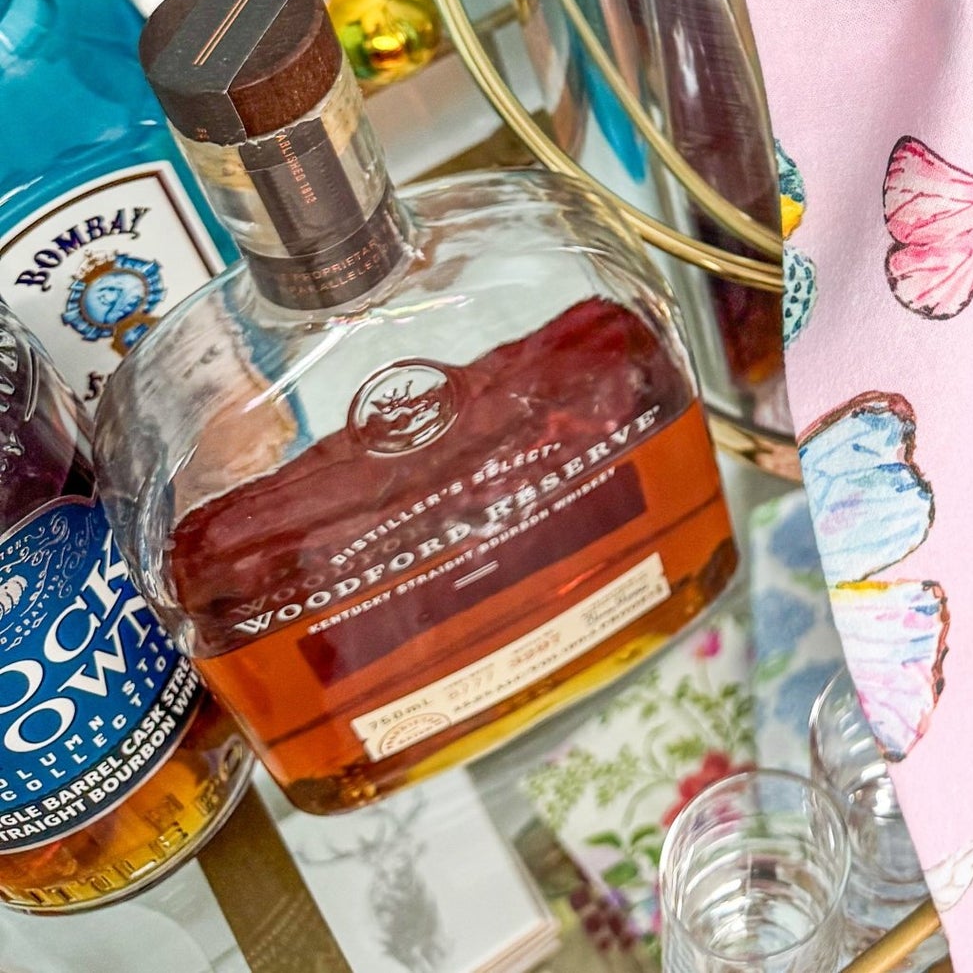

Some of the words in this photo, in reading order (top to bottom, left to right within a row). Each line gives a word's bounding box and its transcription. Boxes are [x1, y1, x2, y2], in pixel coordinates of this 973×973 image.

[15, 206, 151, 293] BOMBAY
[231, 523, 472, 635] WOODFORD
[484, 406, 658, 523] RESERVE
[307, 590, 392, 635] KENTUCKY
[396, 550, 474, 595] STRAIGHT
[477, 508, 550, 555] BOURBON
[329, 482, 464, 565] DISTILLER'S
[0, 805, 42, 828] GLE
[42, 756, 124, 811] BARREL
[121, 703, 166, 755] CASK
[88, 715, 176, 804] BOURBON
